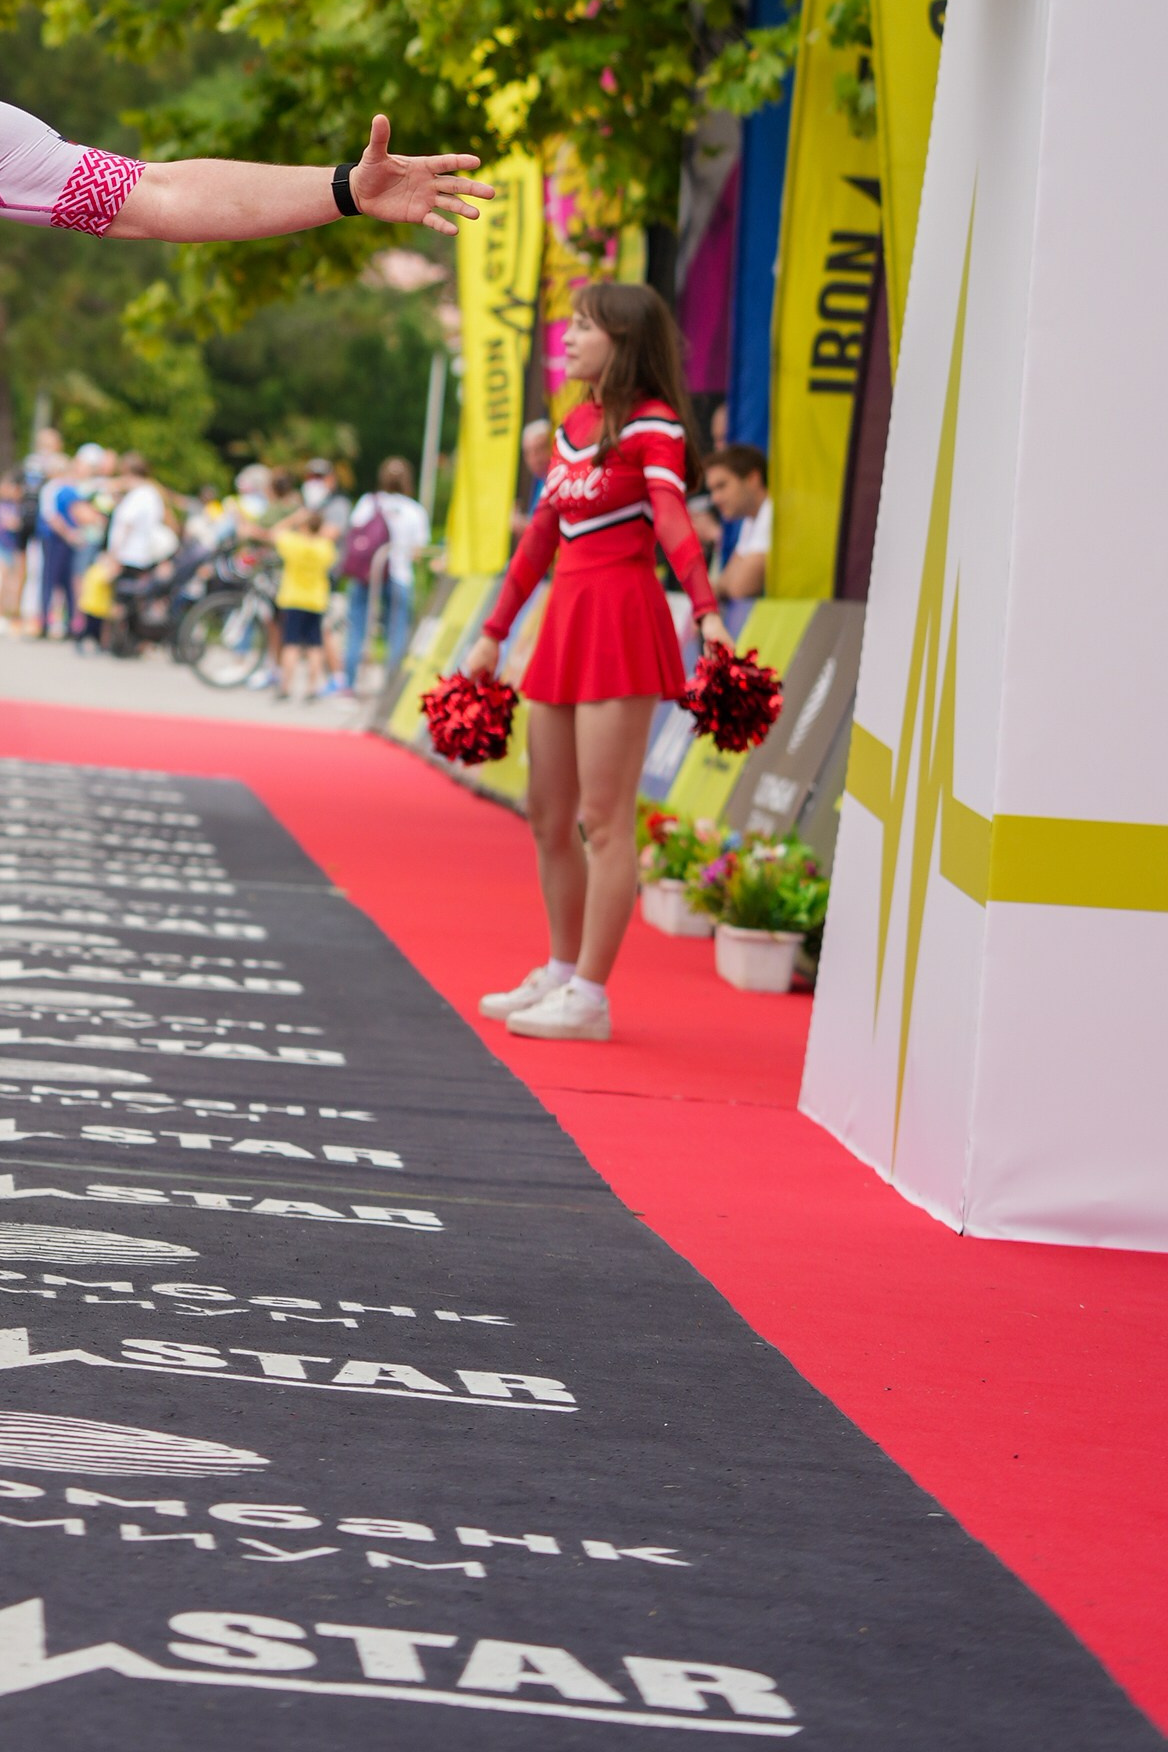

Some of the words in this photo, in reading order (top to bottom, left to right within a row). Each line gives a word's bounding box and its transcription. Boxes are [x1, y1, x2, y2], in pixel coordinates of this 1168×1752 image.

[80, 1125, 404, 1169] STAR
[85, 1184, 445, 1227] STAR
[121, 1339, 577, 1404] STAR
[168, 1612, 795, 1719] STAR
